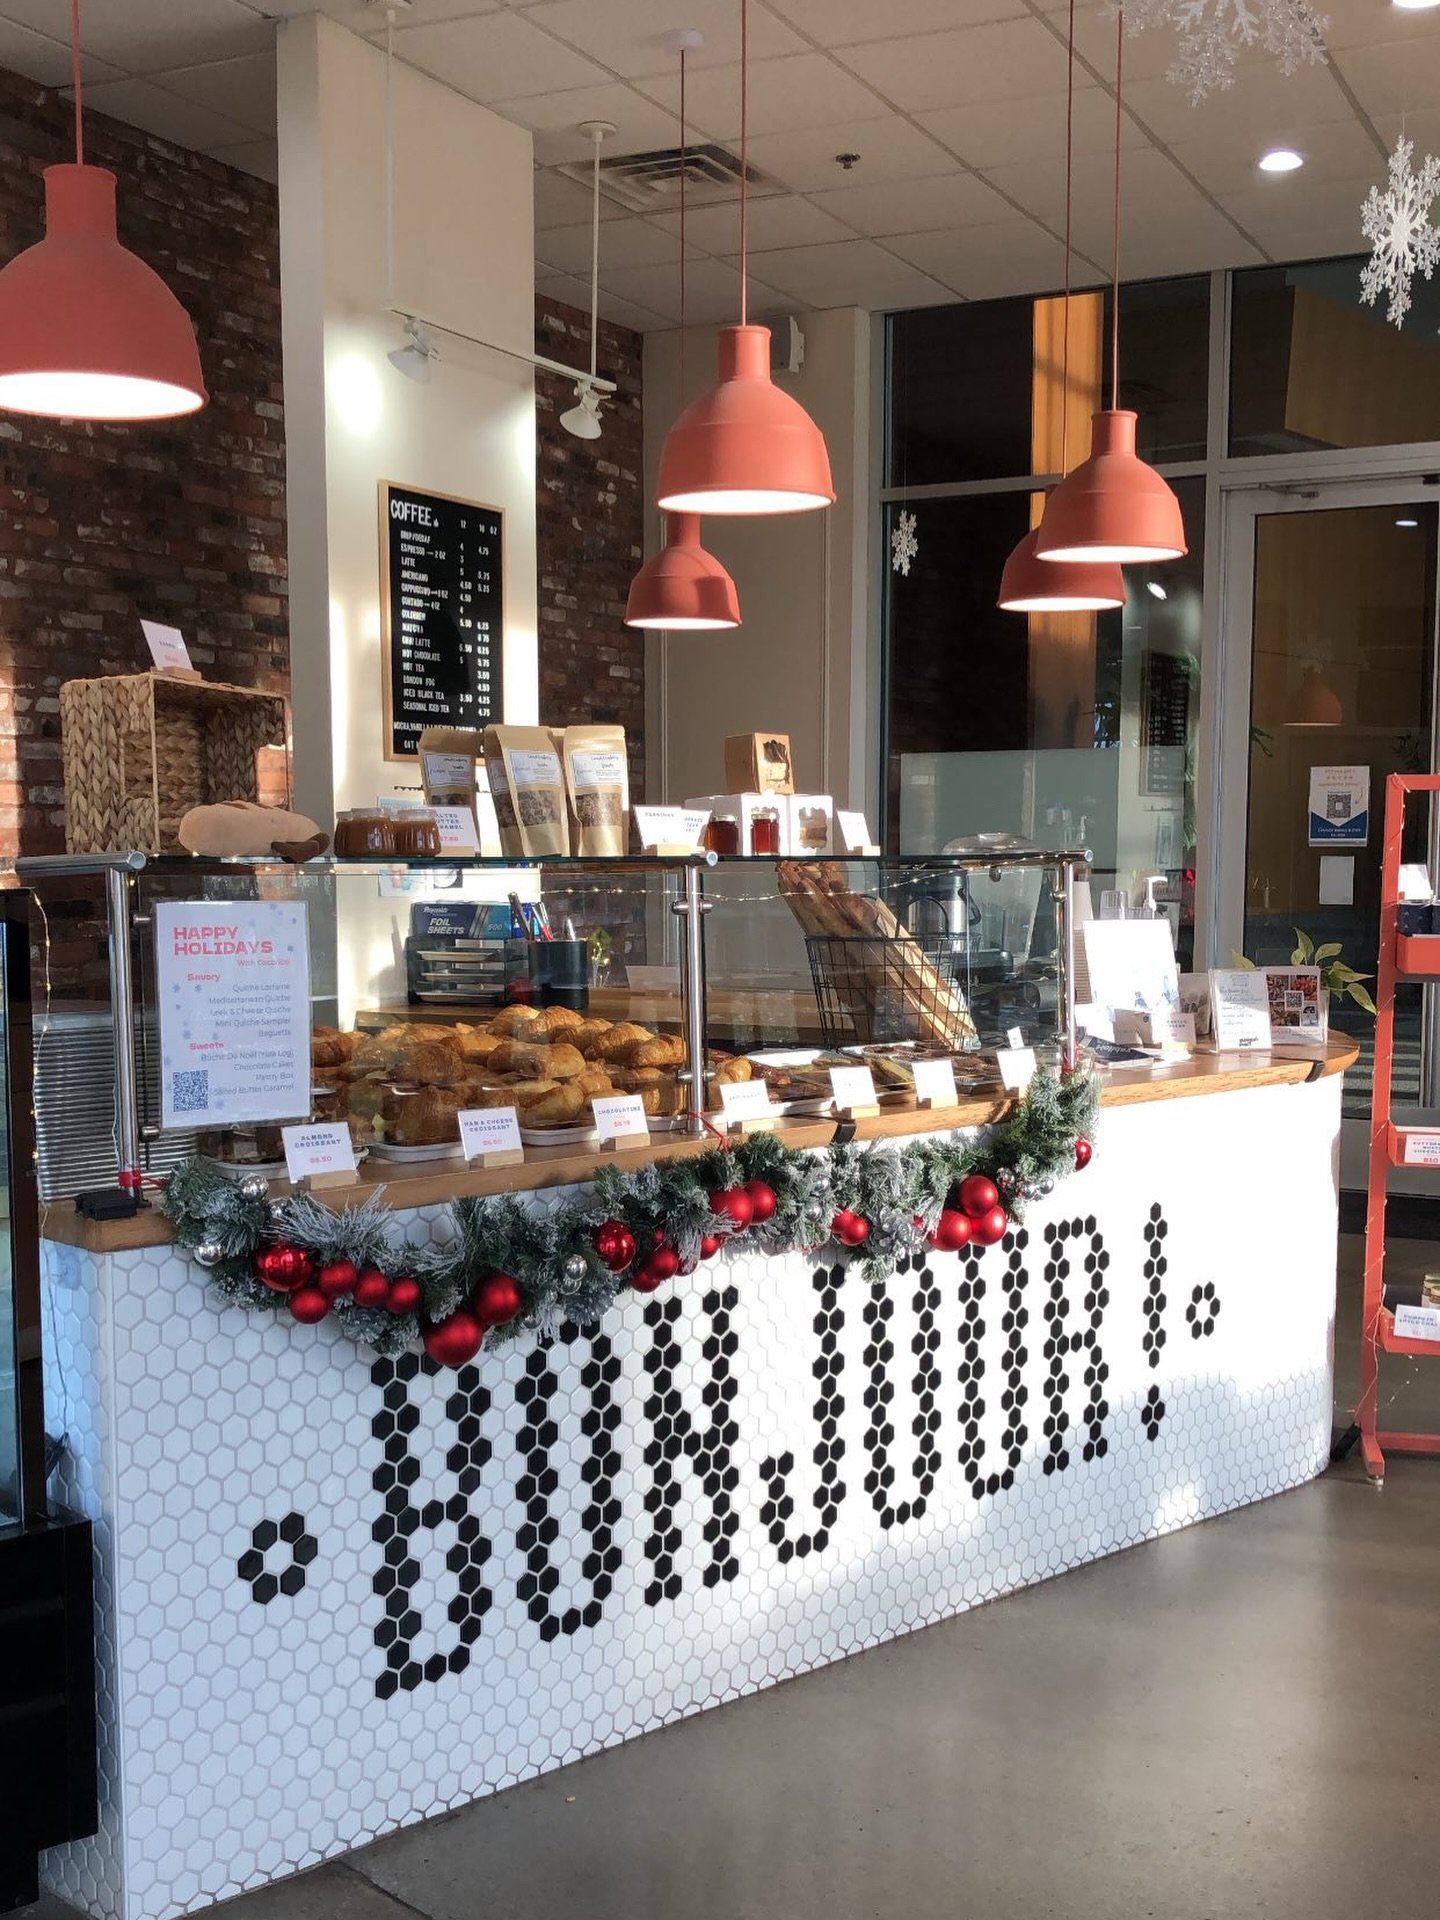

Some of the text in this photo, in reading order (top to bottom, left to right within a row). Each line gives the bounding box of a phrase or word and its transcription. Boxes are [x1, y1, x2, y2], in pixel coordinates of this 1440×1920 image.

[391, 499, 432, 527] COFFEE
[402, 555, 416, 566] LATTE
[416, 636, 431, 647] LATTE
[416, 663, 425, 672] TEA
[436, 691, 445, 700] TEA
[430, 918, 451, 926] FOIL
[173, 926, 238, 940] HAPPY
[427, 926, 465, 935] SHEETS
[174, 941, 273, 955] HOLIDAYS
[187, 973, 221, 983] Savory
[189, 1042, 225, 1051] Sweets
[233, 1062, 271, 1072] Chocolate
[263, 1082, 295, 1092] Caramel
[468, 1124, 511, 1133] CROISSANT
[301, 1133, 334, 1142] ALMOND
[293, 1139, 342, 1149] CROISSANT
